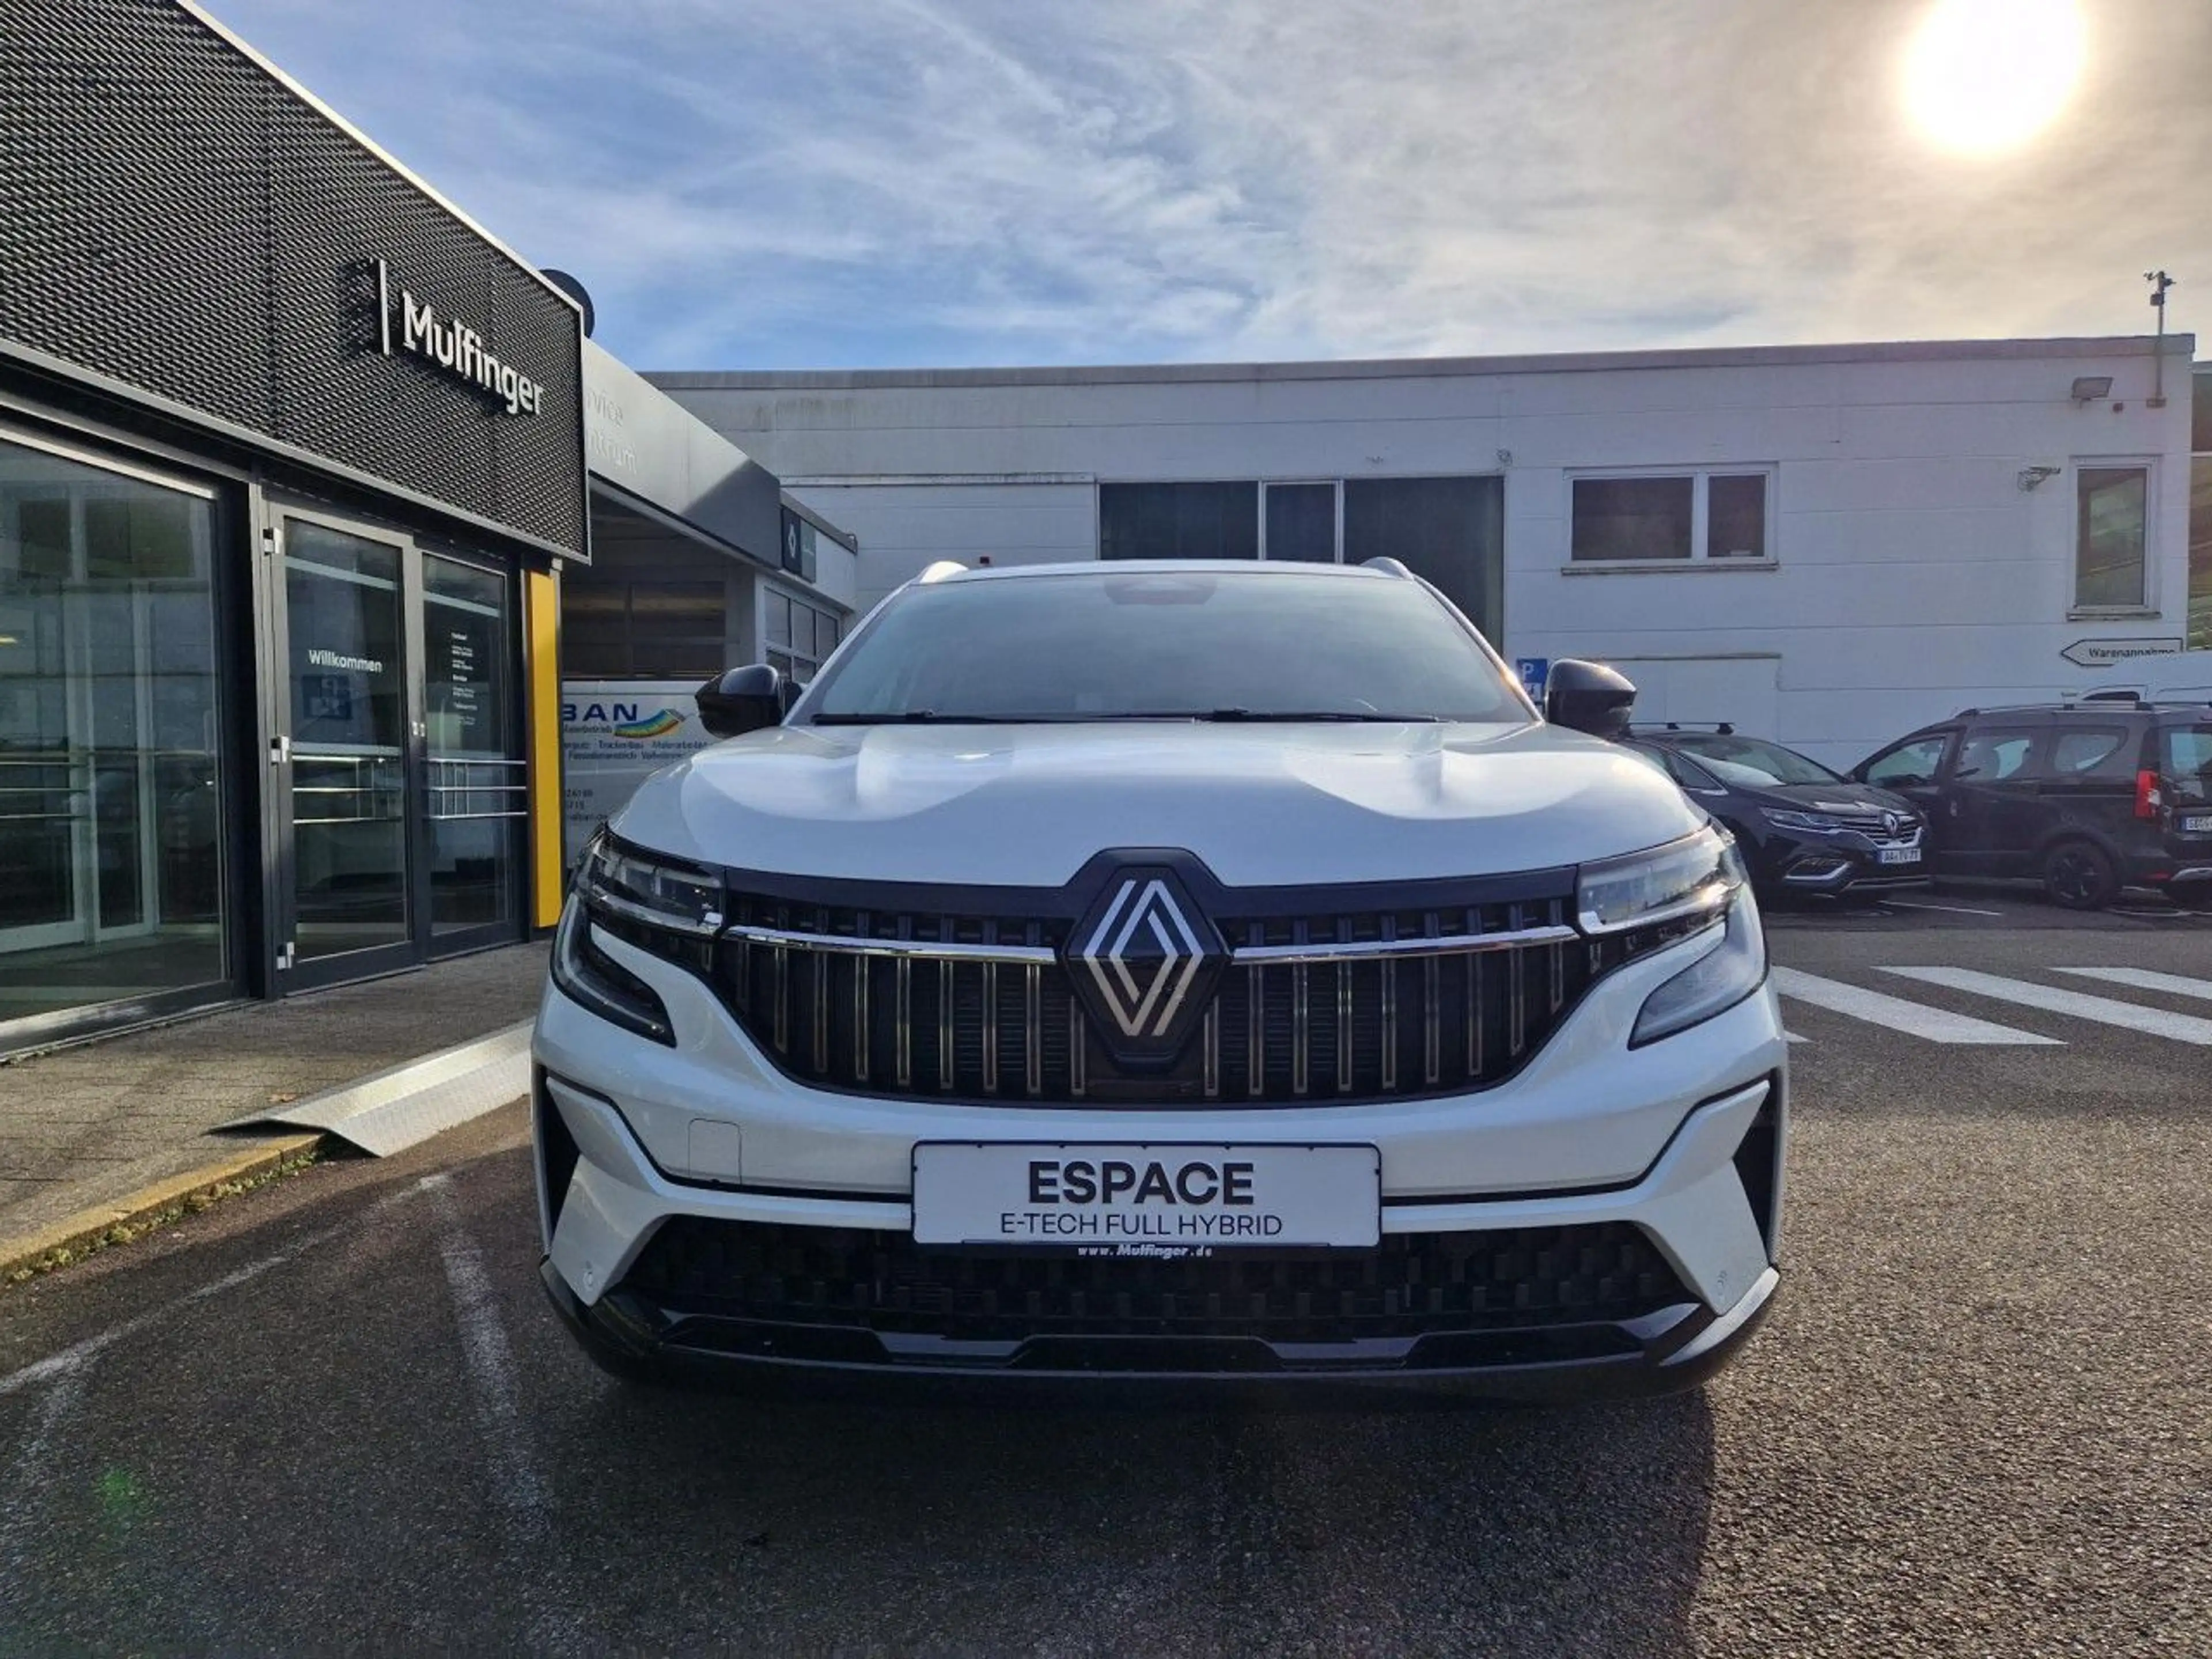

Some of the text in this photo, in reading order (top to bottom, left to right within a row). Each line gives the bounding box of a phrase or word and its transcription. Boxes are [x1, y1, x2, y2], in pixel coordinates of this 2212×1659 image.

[403, 290, 544, 415] Mulfinger
[308, 649, 382, 673] Willkommen
[1522, 662, 1534, 681] P
[1029, 1161, 1255, 1205] ESPACE
[1001, 1213, 1283, 1236] E-TECH FULL HYBRID
